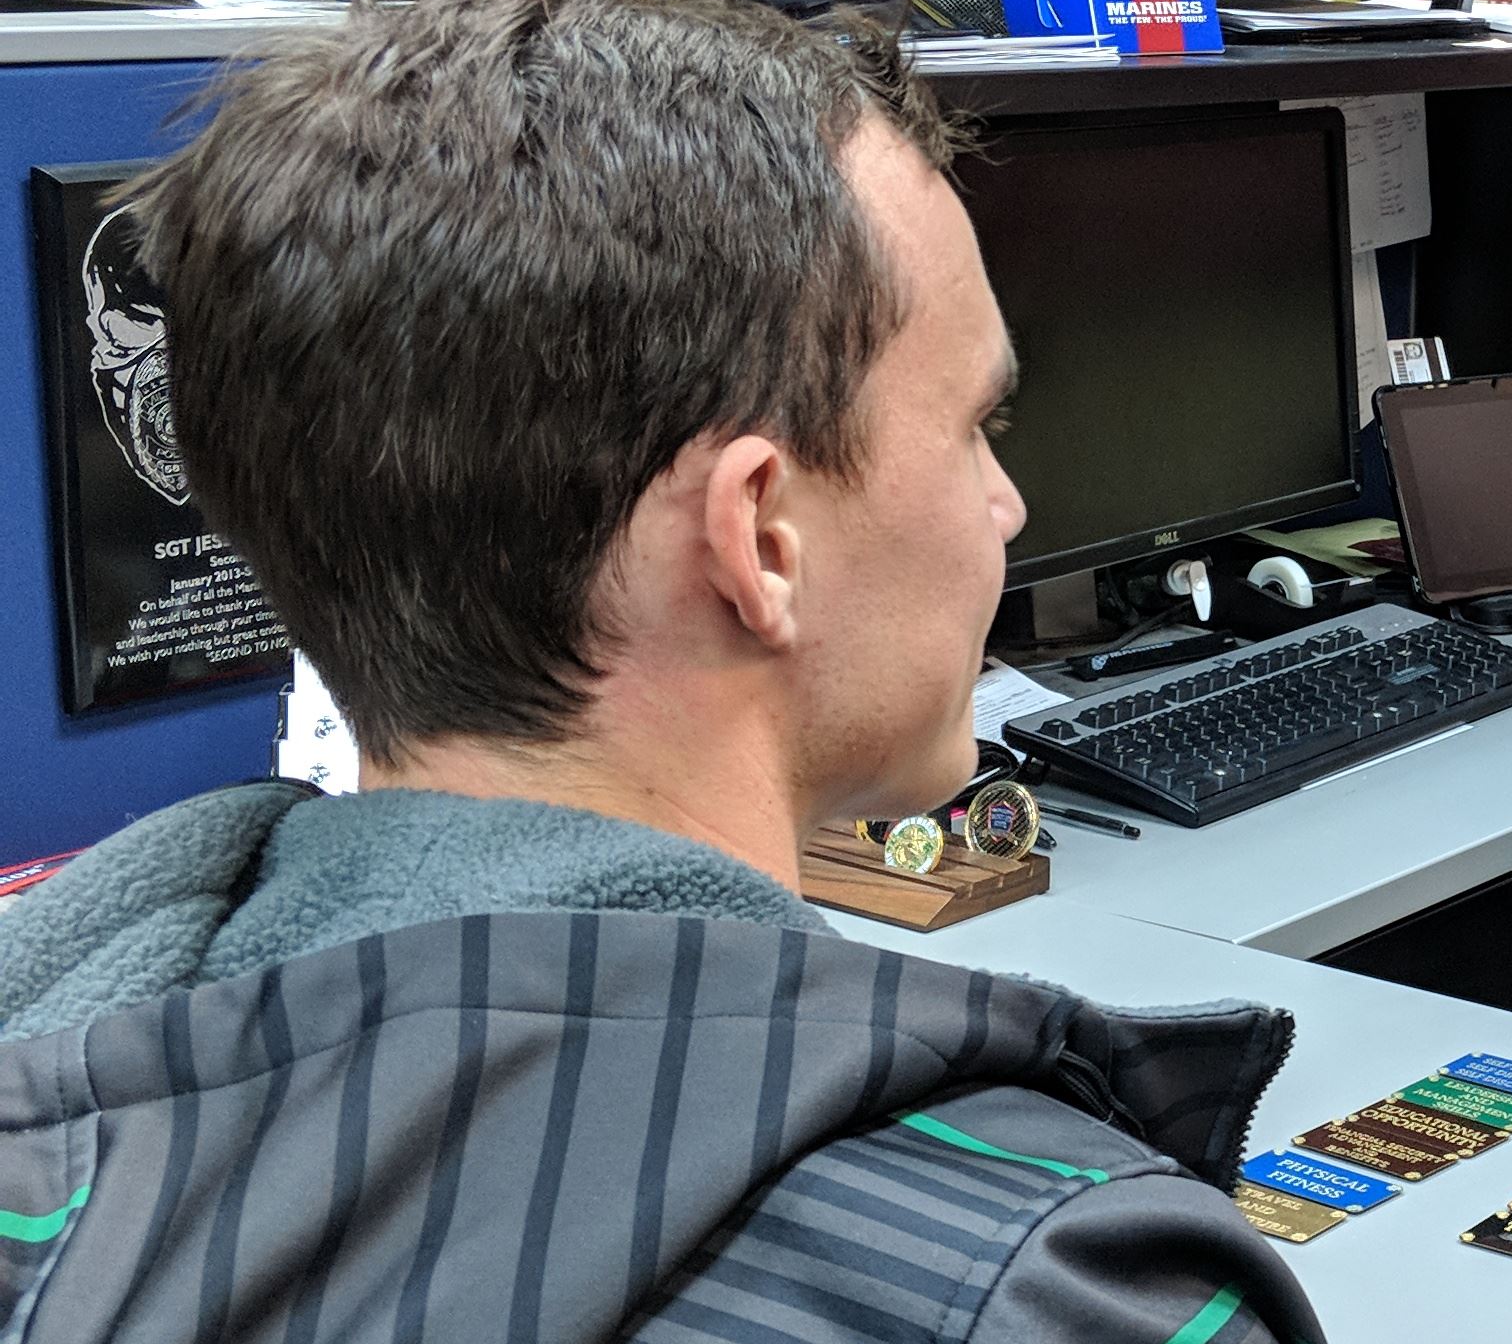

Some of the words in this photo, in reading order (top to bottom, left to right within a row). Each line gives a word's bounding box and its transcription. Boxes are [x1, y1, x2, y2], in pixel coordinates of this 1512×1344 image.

[1105, 0, 1203, 16] MARINES
[1108, 16, 1129, 25] THE
[1154, 15, 1174, 24] THE
[154, 537, 192, 560] SGT
[194, 533, 232, 557] JES
[1154, 530, 1181, 546] DELL
[170, 574, 213, 594] January
[213, 565, 253, 583] 2013-S
[139, 600, 157, 613] On
[158, 592, 190, 610] behalf
[190, 589, 202, 603] of
[203, 588, 215, 601] all
[216, 586, 234, 598] the
[127, 617, 148, 631] We
[148, 610, 181, 627] would
[182, 608, 201, 621] like
[201, 606, 214, 617] to
[215, 599, 243, 614] thank
[243, 597, 263, 611] you
[115, 638, 135, 650] and
[136, 626, 189, 647] leadership
[189, 617, 230, 636] through
[230, 614, 254, 631] your
[107, 654, 127, 668] We
[127, 649, 152, 664] wish
[153, 647, 173, 662] you
[174, 638, 213, 655] nothing
[212, 634, 232, 646] but
[231, 629, 259, 645] great
[253, 639, 269, 654] TO
[1454, 1068, 1484, 1081] SELF
[1465, 1062, 1495, 1075] SELF
[1482, 1057, 1511, 1070] SELF
[1432, 1100, 1482, 1119] SKILLS
[1460, 1093, 1496, 1108] AND
[1360, 1109, 1486, 1149] OPPORTUNITY
[1376, 1103, 1491, 1143] EDUCATIONAL
[1324, 1144, 1391, 1169] BENEFITS
[1327, 1132, 1424, 1164] ADVANCEMENT
[1385, 1142, 1447, 1164] SECURITY
[1266, 1170, 1345, 1199] FITNESS
[1276, 1158, 1371, 1193] PHYSICAL
[1235, 1200, 1278, 1216] AND
[1242, 1187, 1303, 1211] TRAVEL
